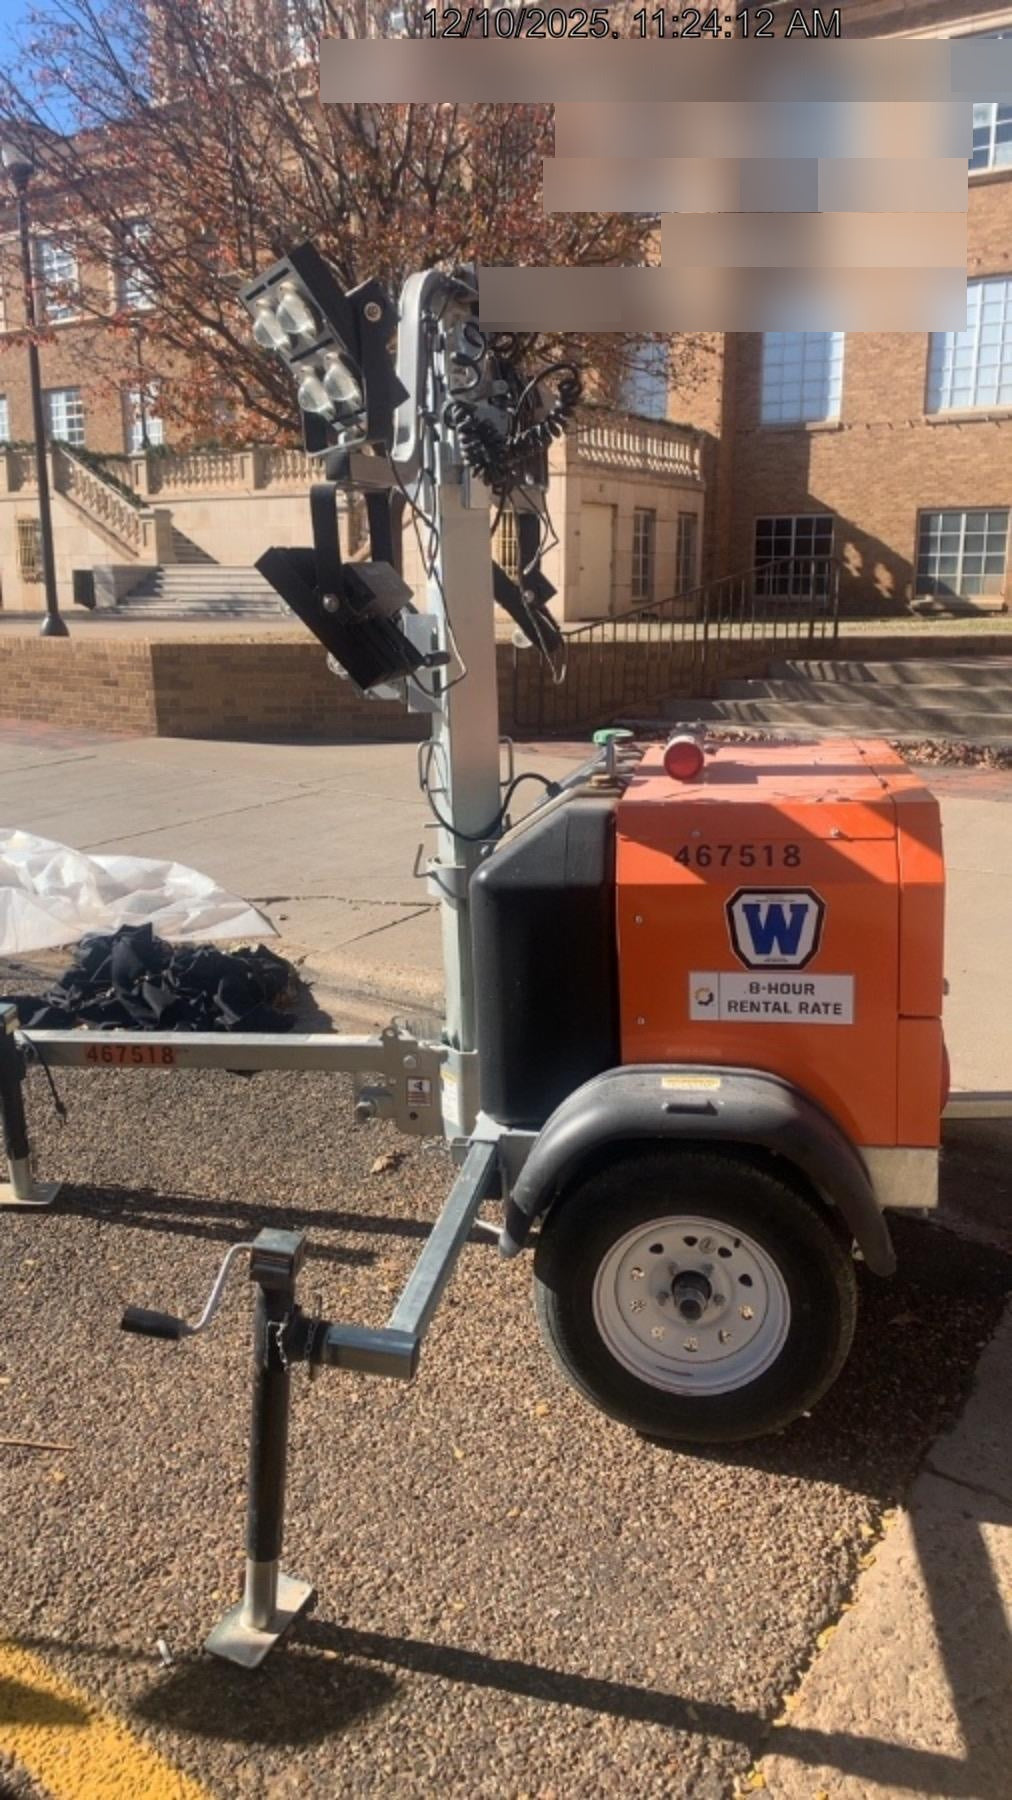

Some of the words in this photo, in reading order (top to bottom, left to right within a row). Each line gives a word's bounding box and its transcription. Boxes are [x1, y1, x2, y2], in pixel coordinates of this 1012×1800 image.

[675, 845, 801, 867] 467518
[742, 904, 809, 955] W
[749, 982, 815, 996] 8-HOUR
[727, 1000, 793, 1014] RENTAL
[799, 1002, 843, 1016] RATE
[86, 1045, 175, 1064] 467518
